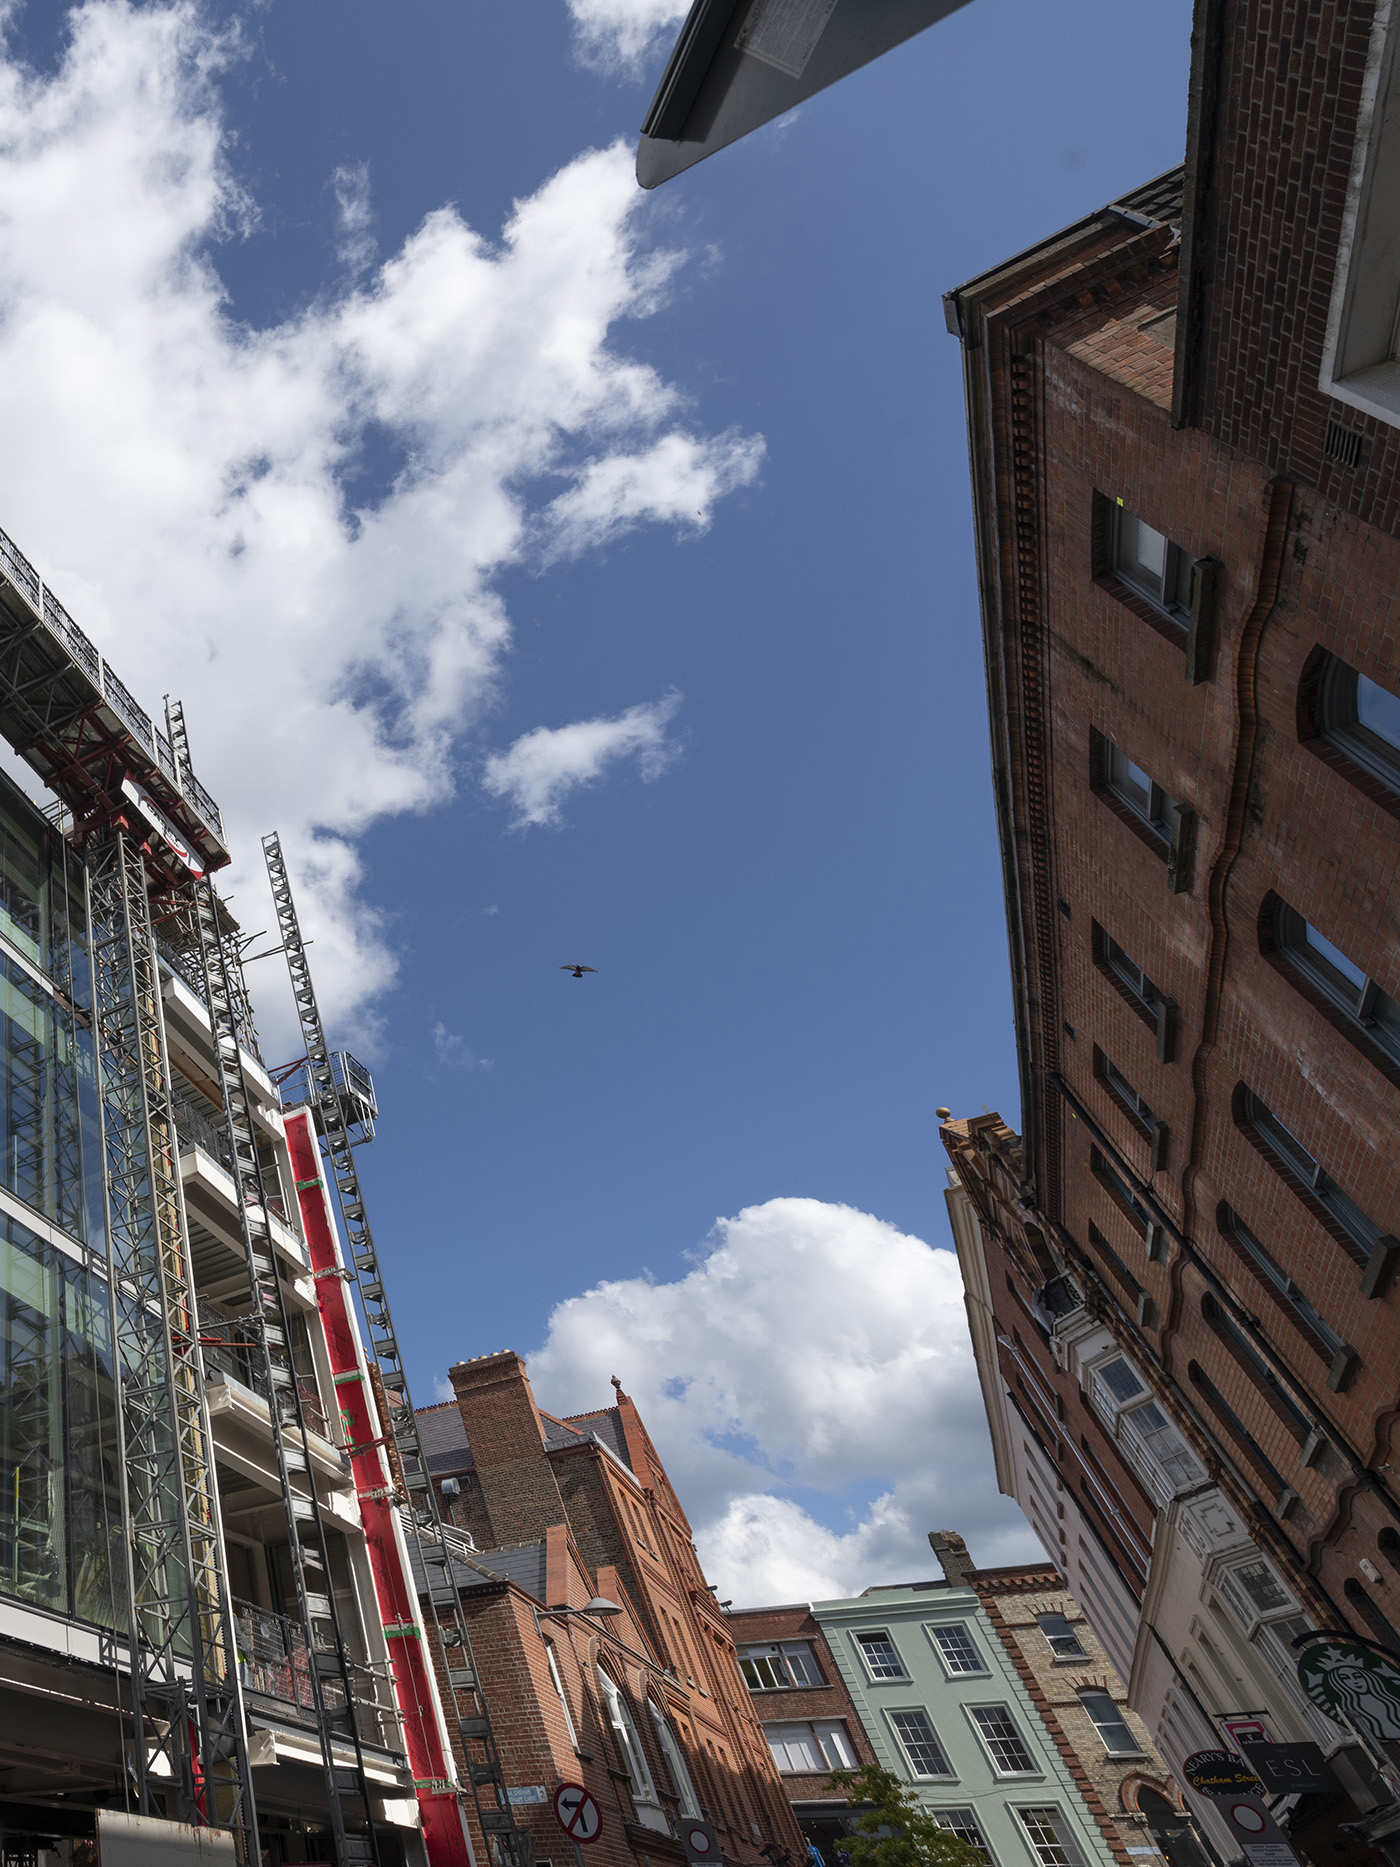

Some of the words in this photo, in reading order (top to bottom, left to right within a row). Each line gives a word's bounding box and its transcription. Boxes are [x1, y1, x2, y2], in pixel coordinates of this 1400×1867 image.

[1186, 1752, 1225, 1776] NEARY'S
[1228, 1754, 1248, 1768] BA
[1265, 1759, 1321, 1777] ESL
[1192, 1775, 1233, 1787] Chatham
